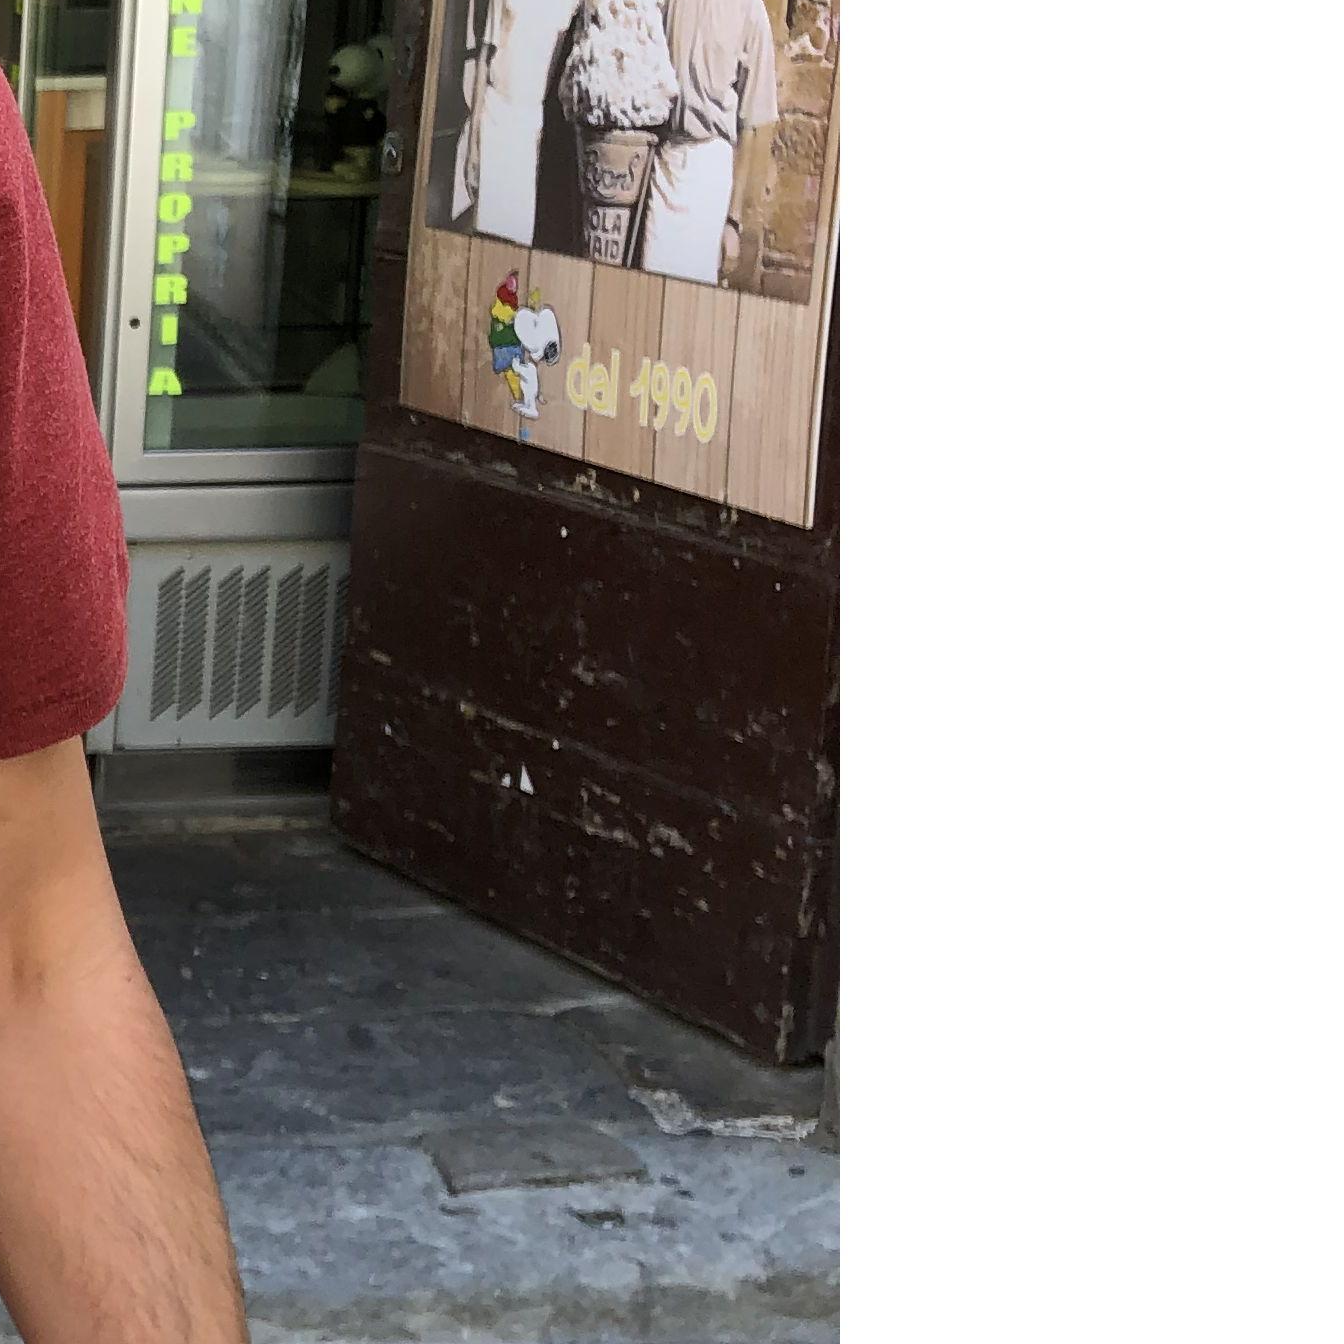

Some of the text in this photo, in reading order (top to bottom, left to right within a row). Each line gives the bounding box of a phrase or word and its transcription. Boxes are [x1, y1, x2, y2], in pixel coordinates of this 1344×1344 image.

[148, 111, 197, 395] PROPRIA
[566, 342, 717, 443] dal 1990
